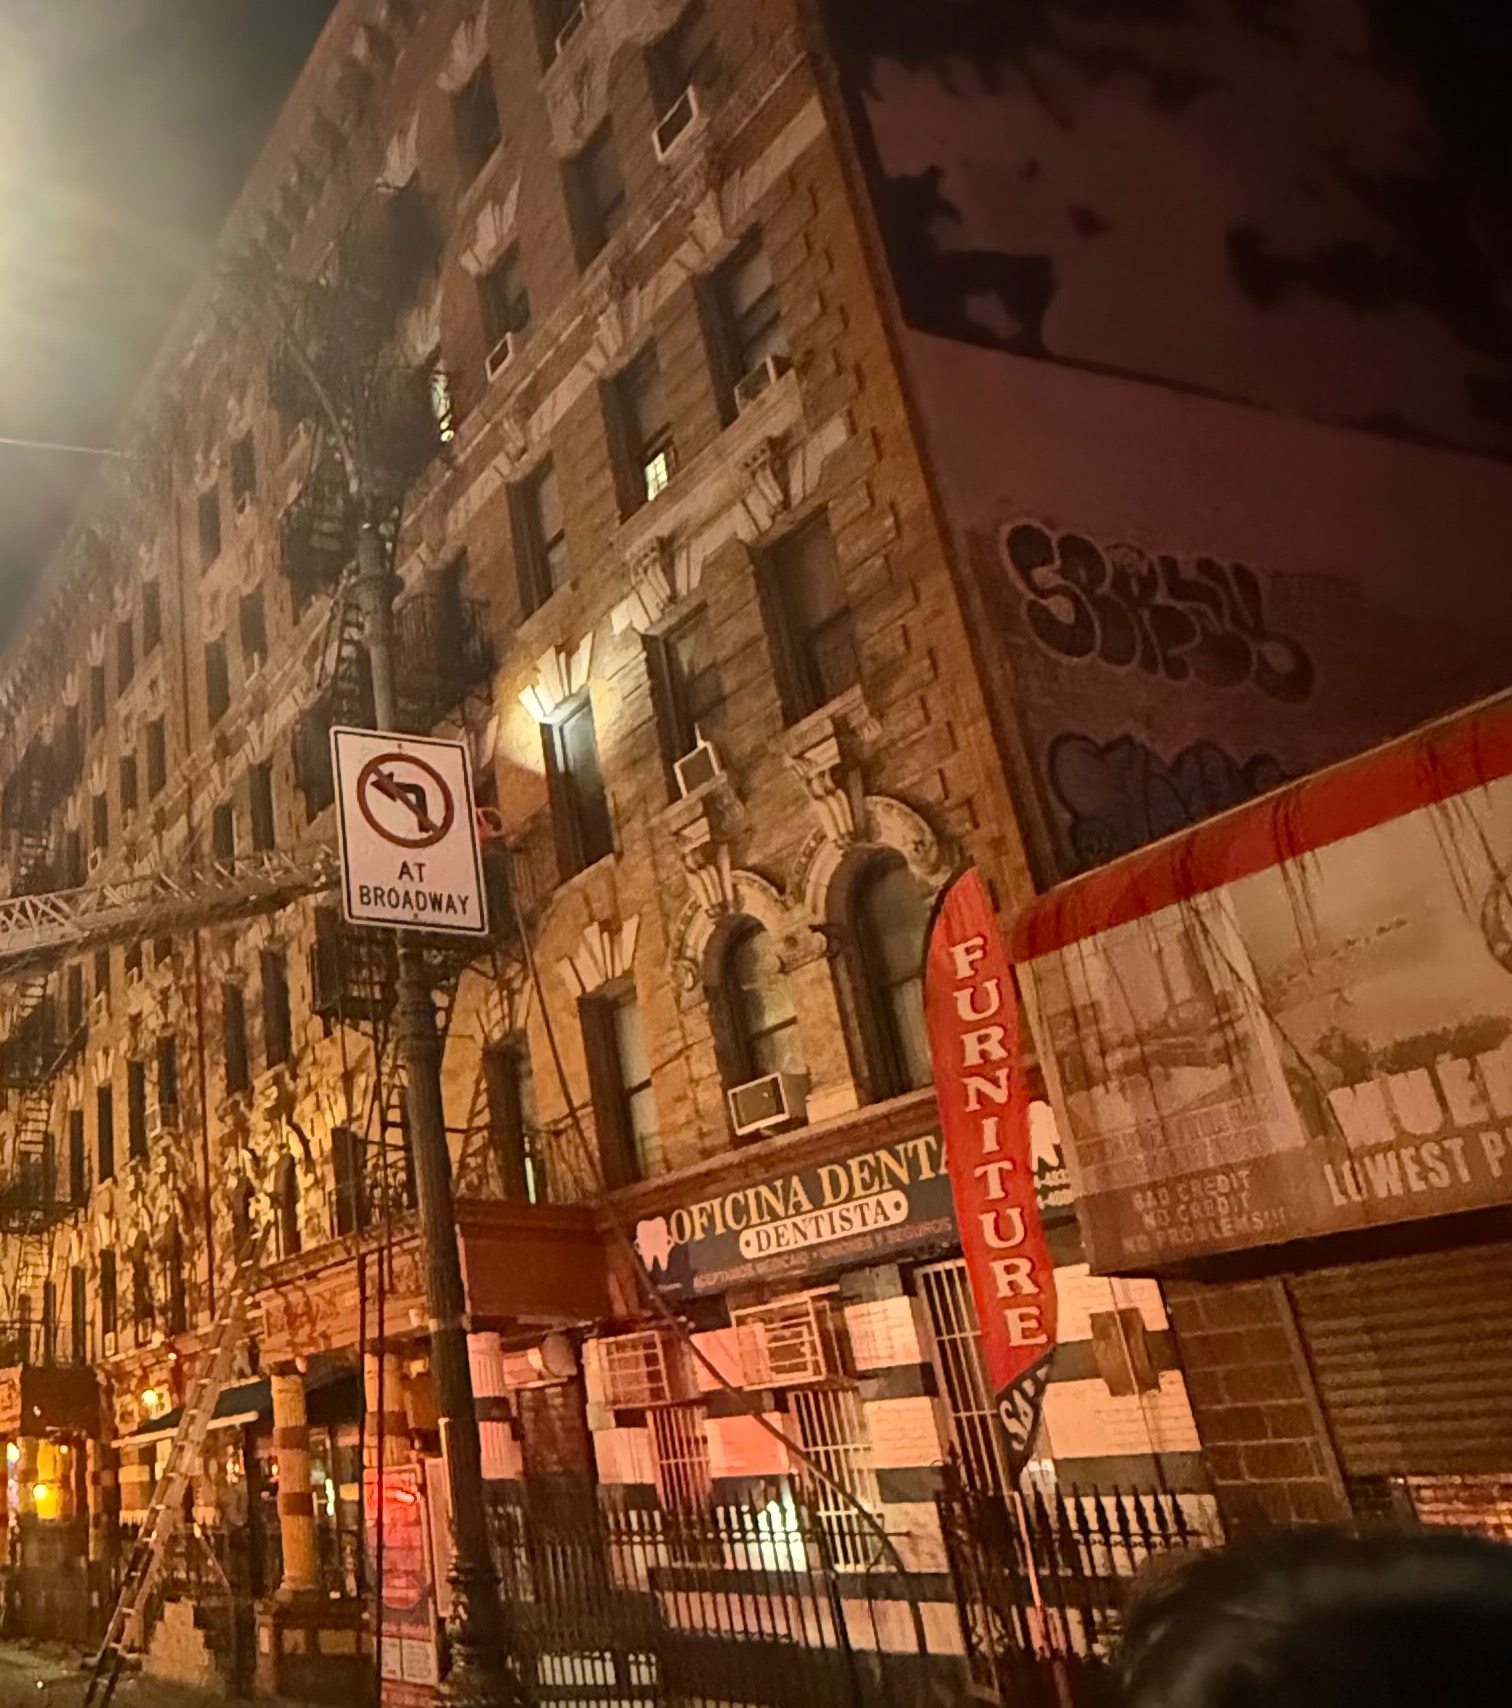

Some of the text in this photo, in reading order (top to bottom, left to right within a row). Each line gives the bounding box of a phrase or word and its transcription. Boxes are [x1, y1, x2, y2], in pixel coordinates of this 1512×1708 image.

[398, 861, 426, 883] AT
[359, 885, 469, 915] BROADWAY
[949, 936, 1048, 1347] FURNITURE
[1176, 1170, 1250, 1201] CREDIT
[1324, 1127, 1512, 1206] LOWEST P
[670, 1175, 812, 1245] OFICINA
[817, 1135, 950, 1205] DENT
[1176, 1190, 1248, 1222] CREDIT
[756, 1195, 891, 1252] DENTISTA
